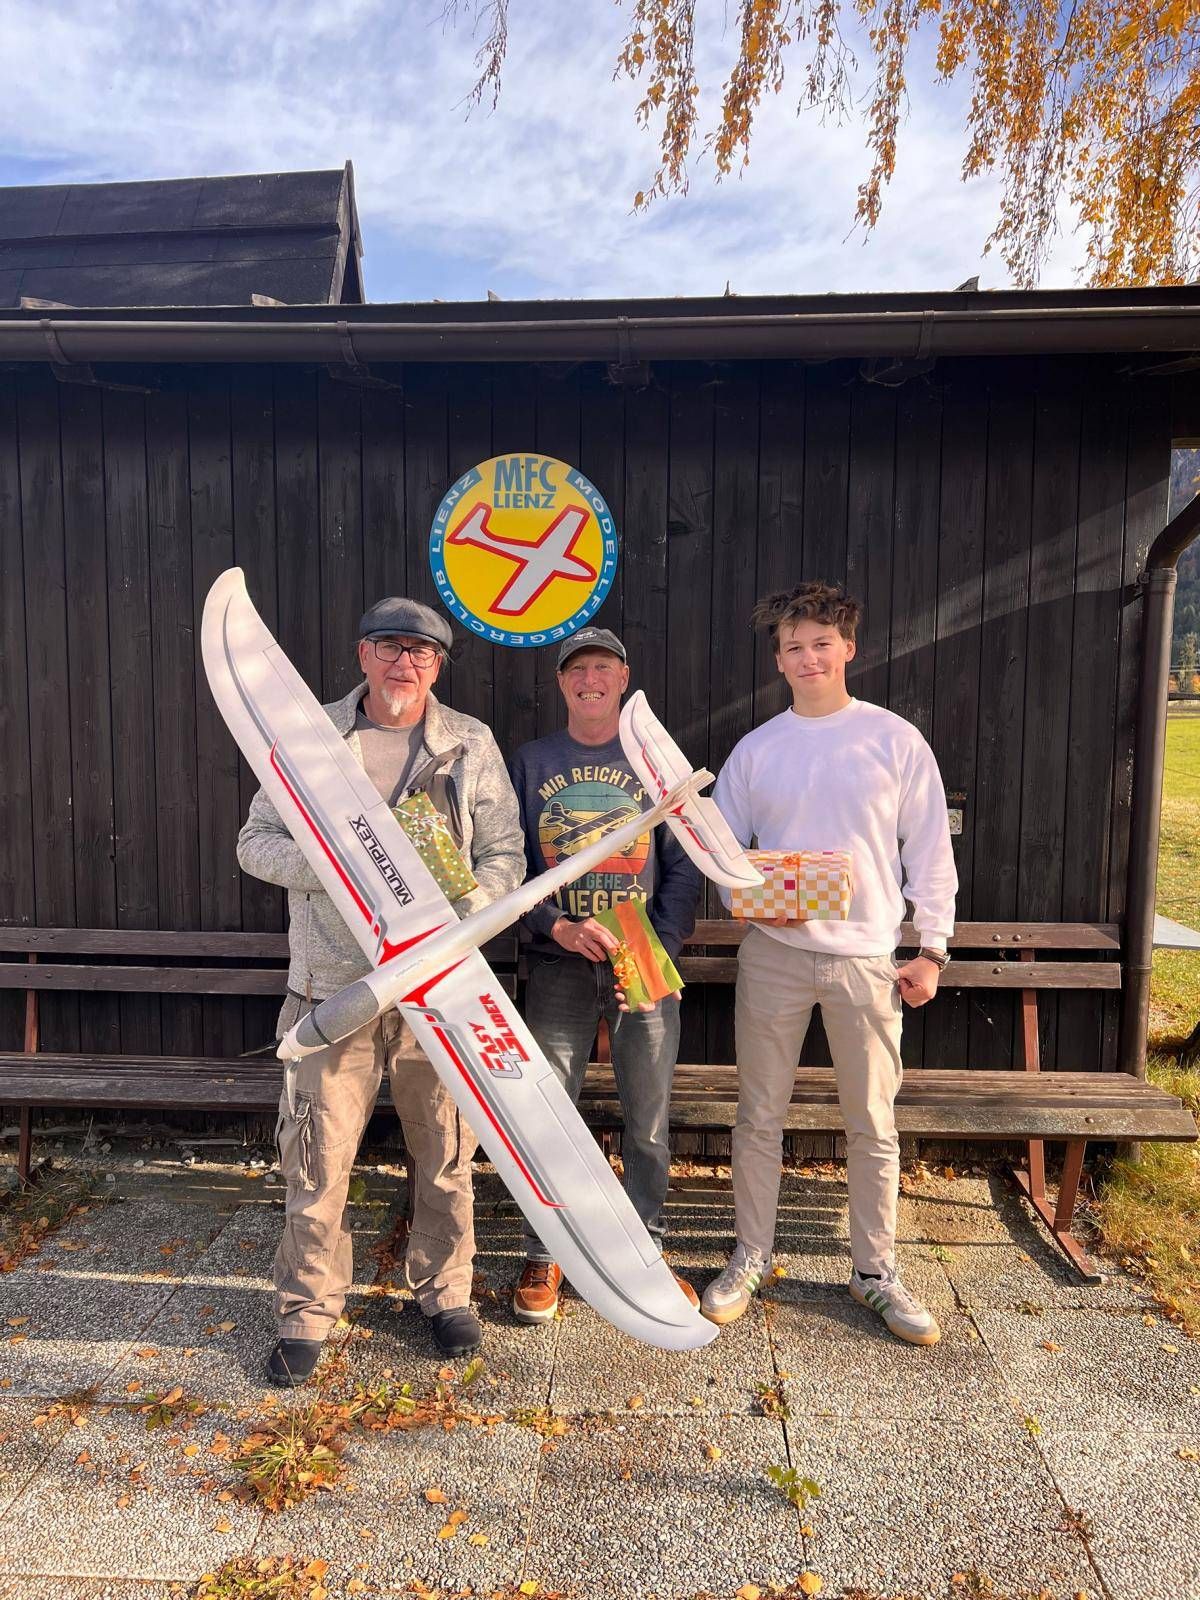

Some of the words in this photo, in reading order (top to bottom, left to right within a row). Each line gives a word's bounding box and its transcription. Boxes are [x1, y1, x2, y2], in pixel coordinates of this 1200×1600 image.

[493, 457, 557, 492] MFC
[432, 474, 475, 553] LIENZ
[493, 493, 555, 509] LIENZ
[435, 476, 615, 645] MODELLFLIEGERCLUB
[538, 773, 569, 802] MIR
[351, 815, 413, 906] MULTIPLEX
[586, 873, 623, 890] GEHE
[467, 1021, 505, 1070] EASY
